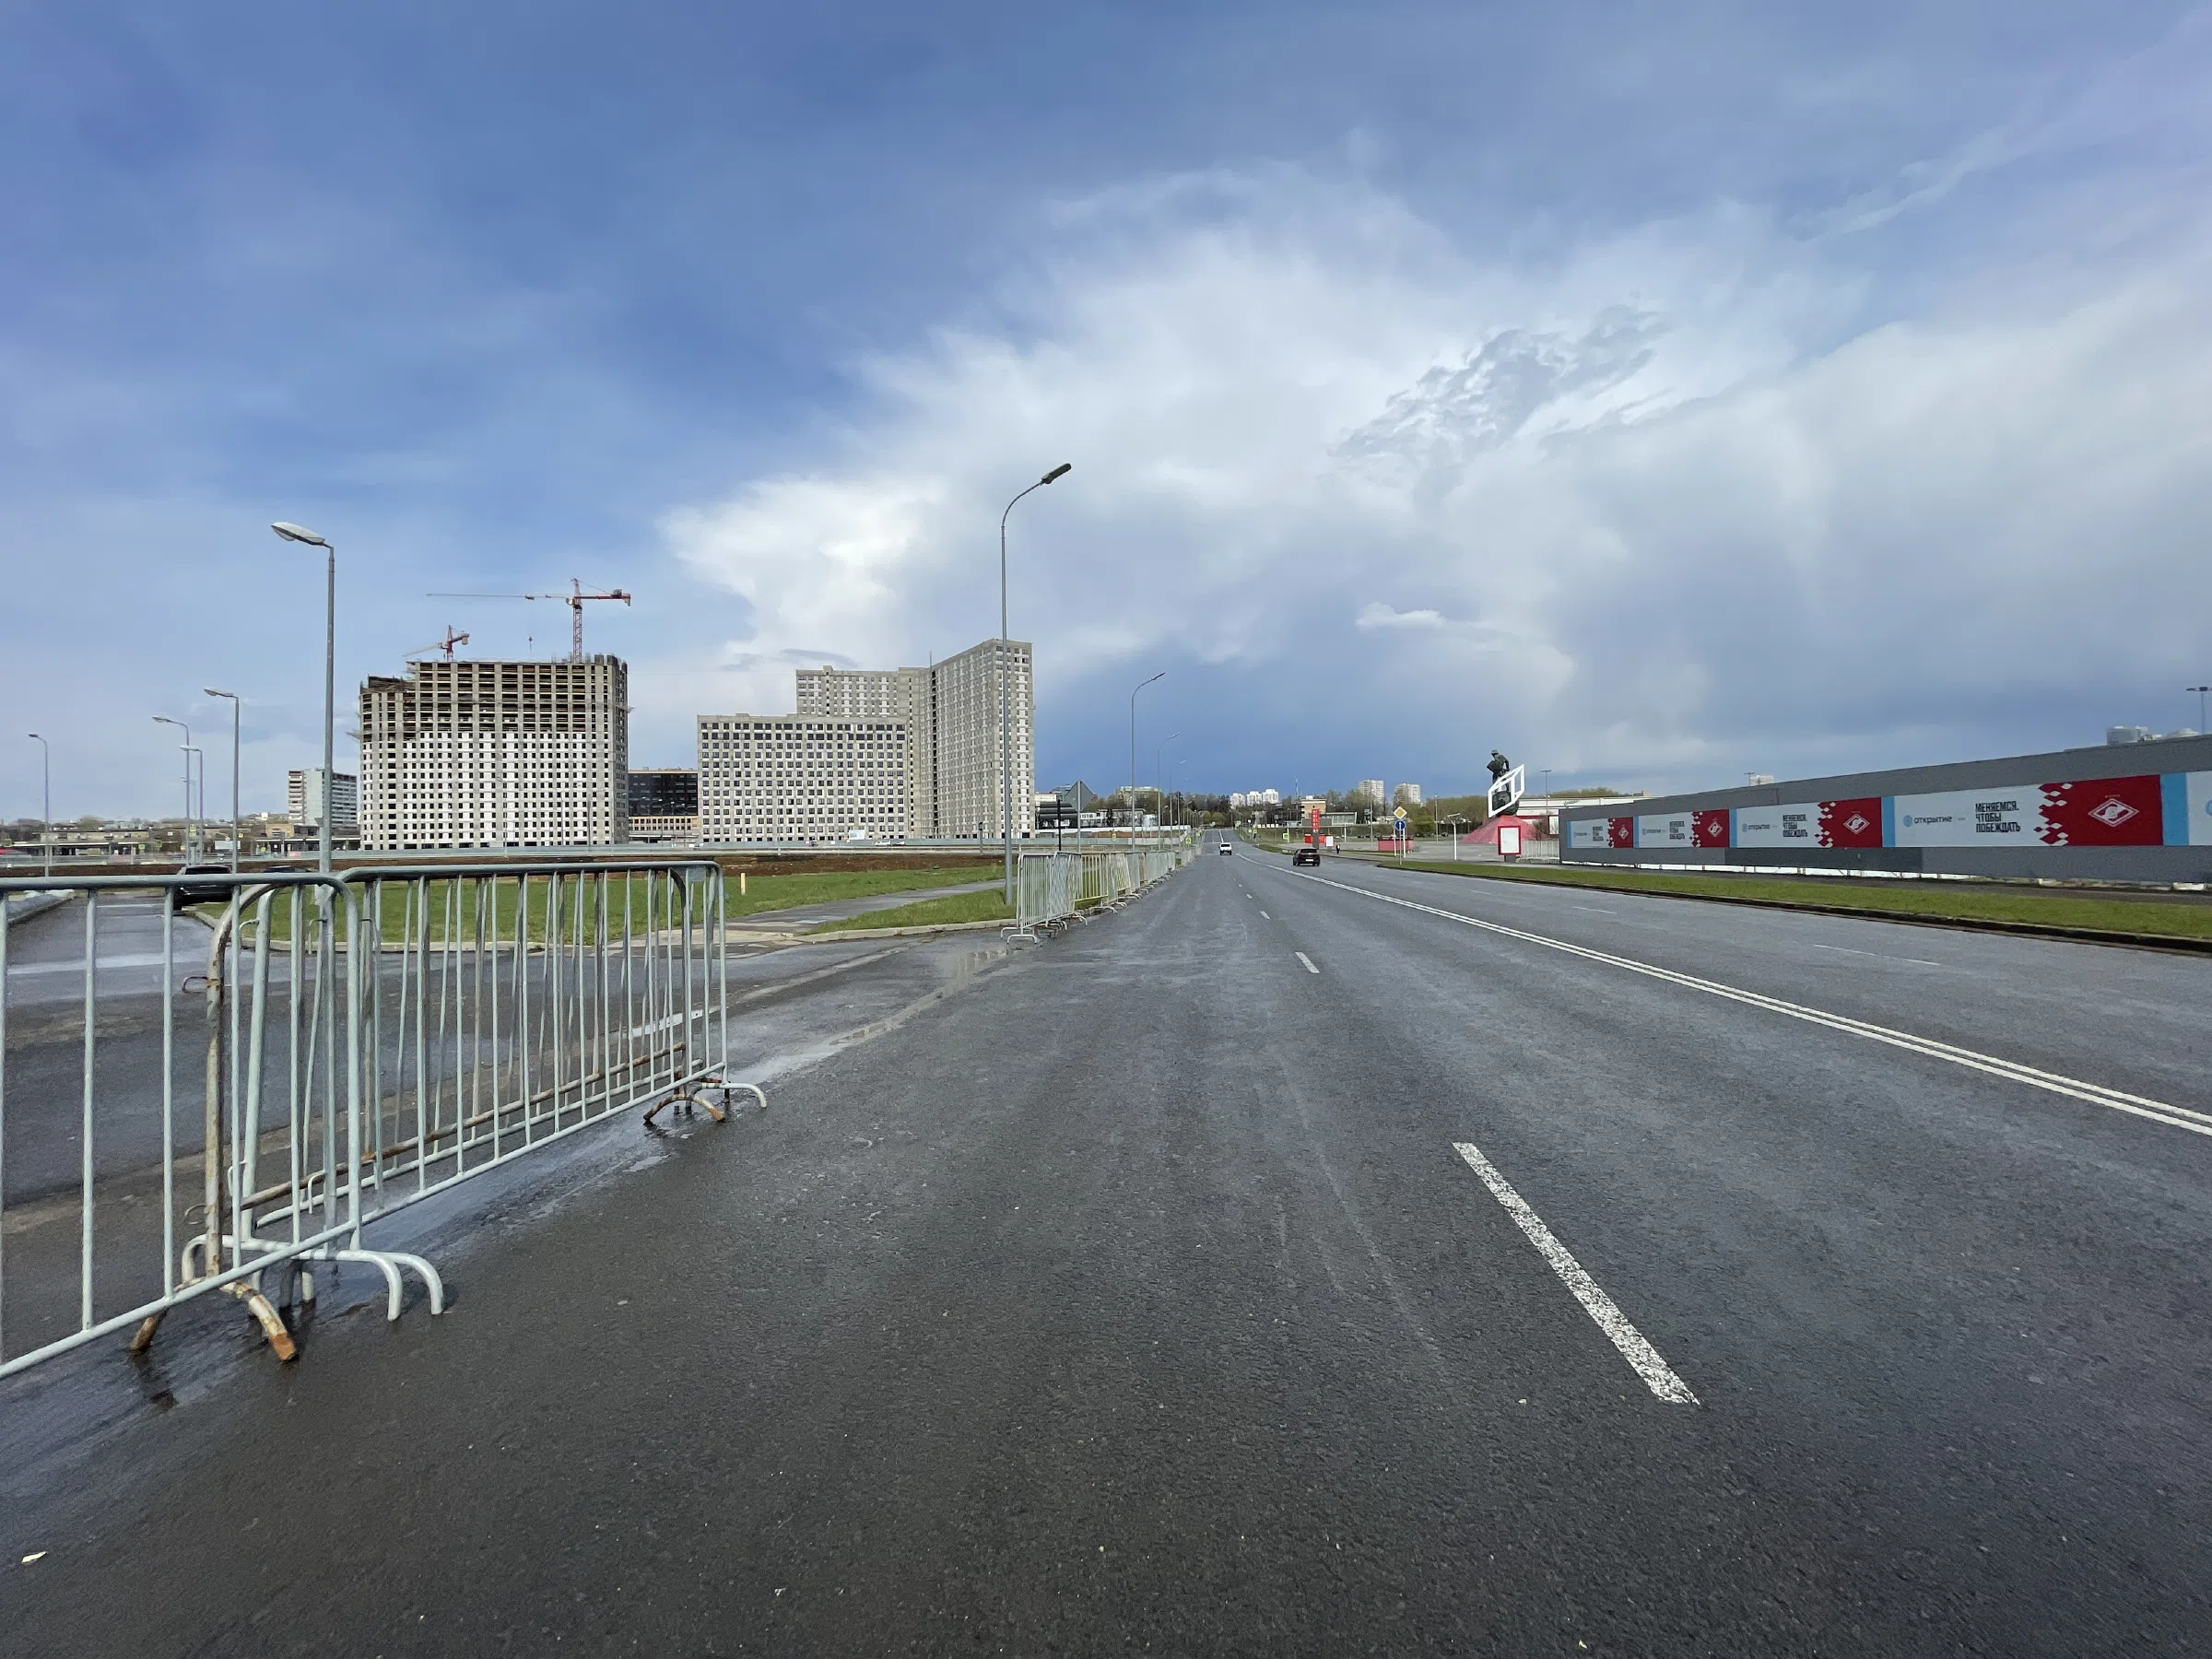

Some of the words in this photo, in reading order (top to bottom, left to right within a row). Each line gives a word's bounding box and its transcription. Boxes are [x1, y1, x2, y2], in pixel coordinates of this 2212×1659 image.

[1914, 816, 1952, 825] открытие
[1975, 813, 2001, 822] ЧТОБЫ
[1976, 822, 2020, 832] ПОБЕЖДАТЬ
